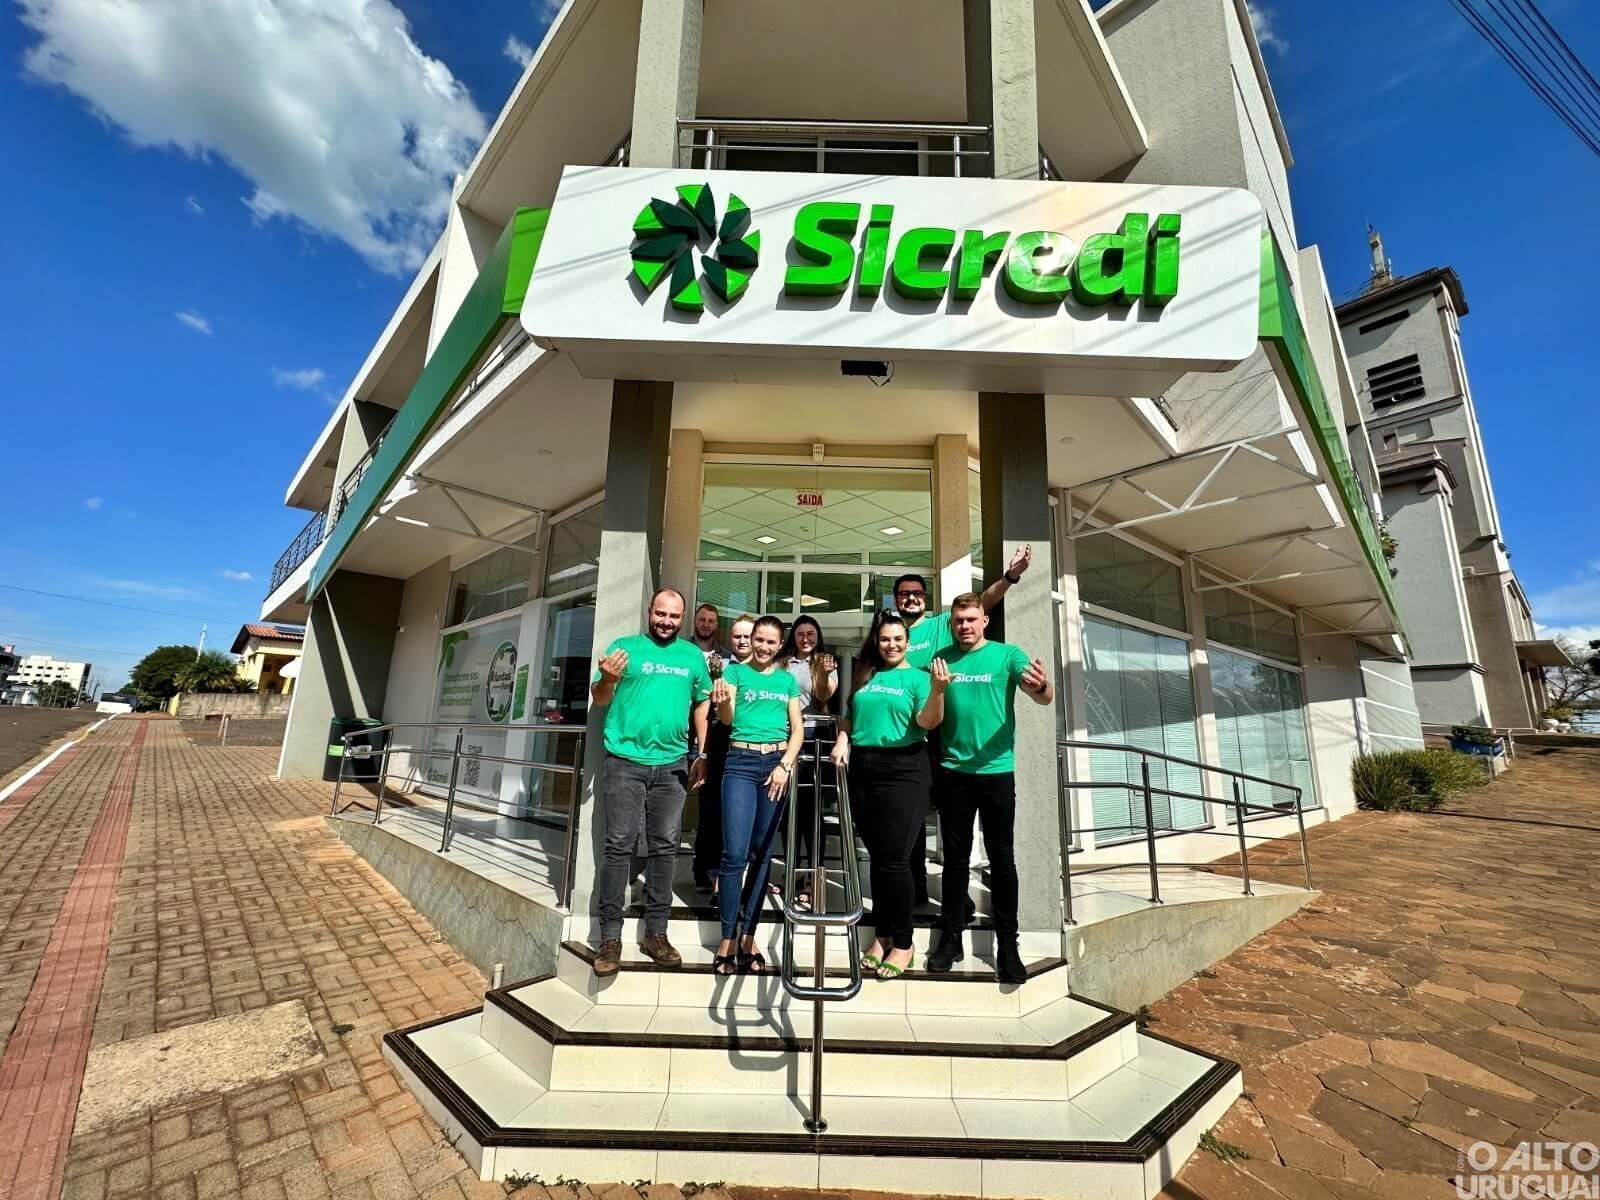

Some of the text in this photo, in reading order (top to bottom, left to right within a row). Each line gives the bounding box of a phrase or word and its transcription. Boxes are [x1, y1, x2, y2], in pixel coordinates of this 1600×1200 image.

[784, 202, 1182, 306] Sicredi
[905, 640, 931, 653] icredi
[655, 663, 690, 677] Sicredi
[953, 672, 992, 683] Sicredi
[758, 690, 789, 703] Sicred
[870, 684, 905, 697] Sicredi
